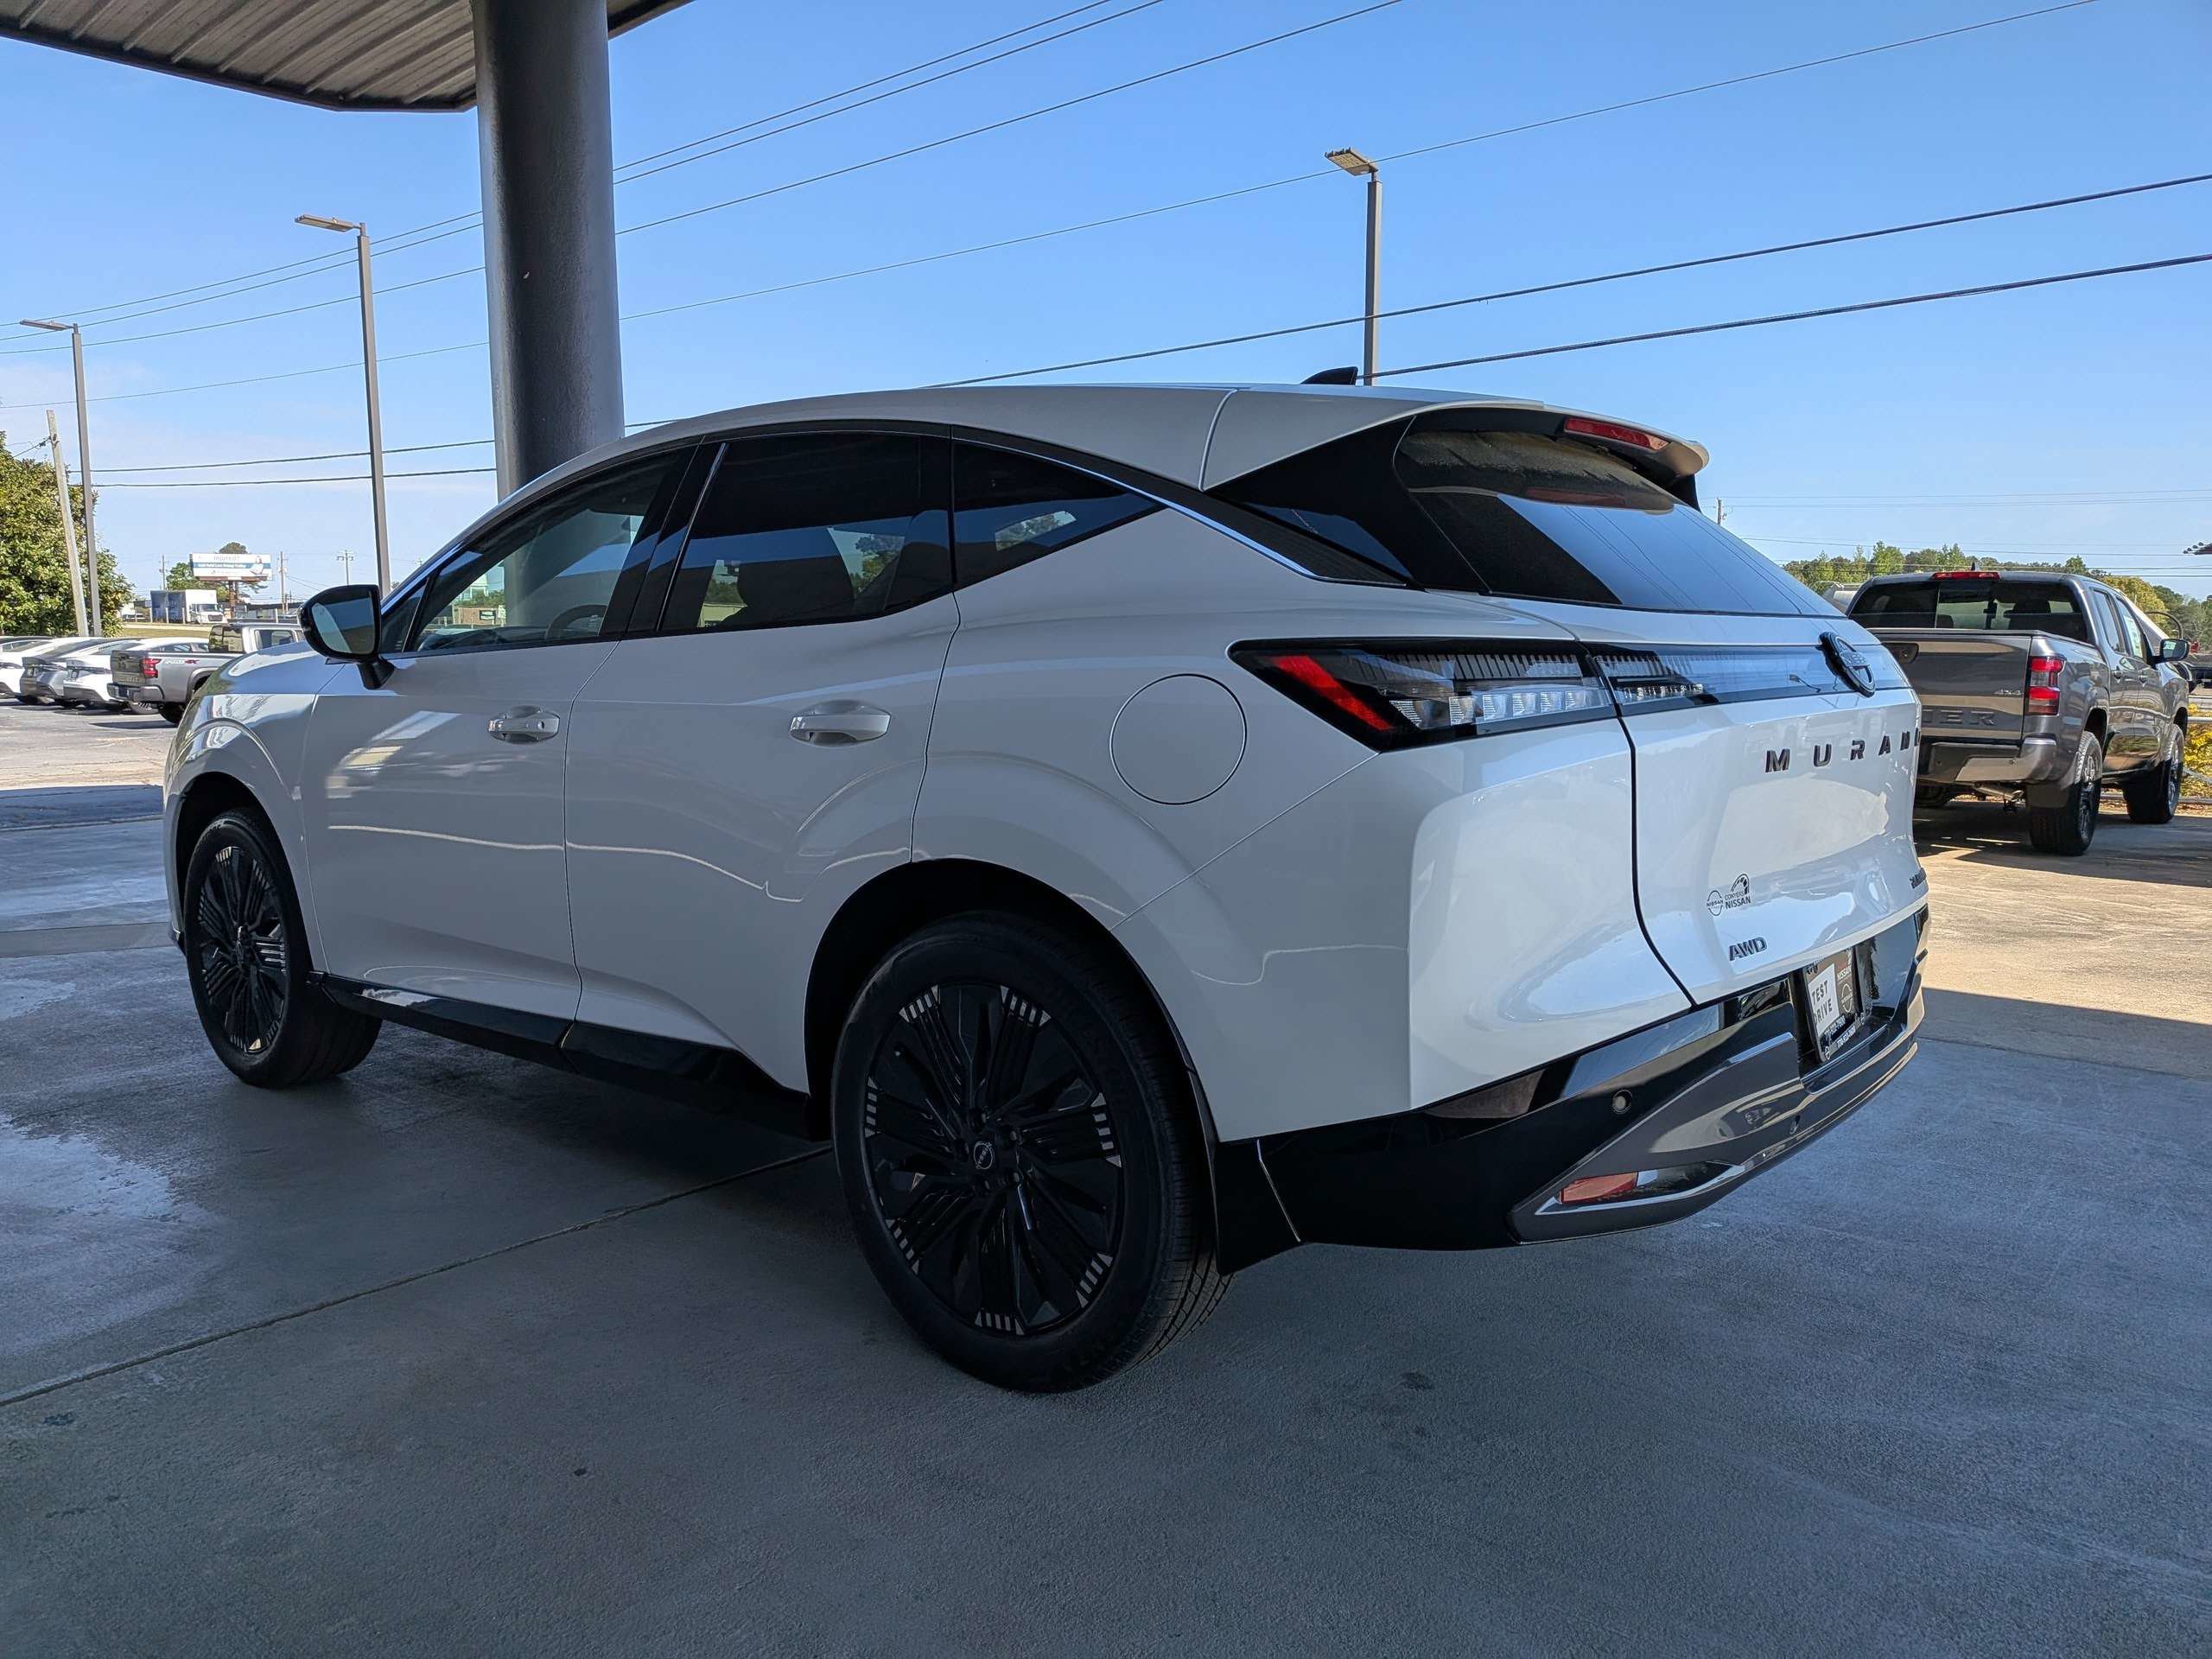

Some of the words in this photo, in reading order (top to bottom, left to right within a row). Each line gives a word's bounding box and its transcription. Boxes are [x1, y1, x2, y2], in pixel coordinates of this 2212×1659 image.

[1725, 895, 1751, 910] NISSAN
[1729, 938, 1768, 961] AWD
[1811, 980, 1828, 1005] TEST
[1814, 998, 1833, 1024] DRIVE
